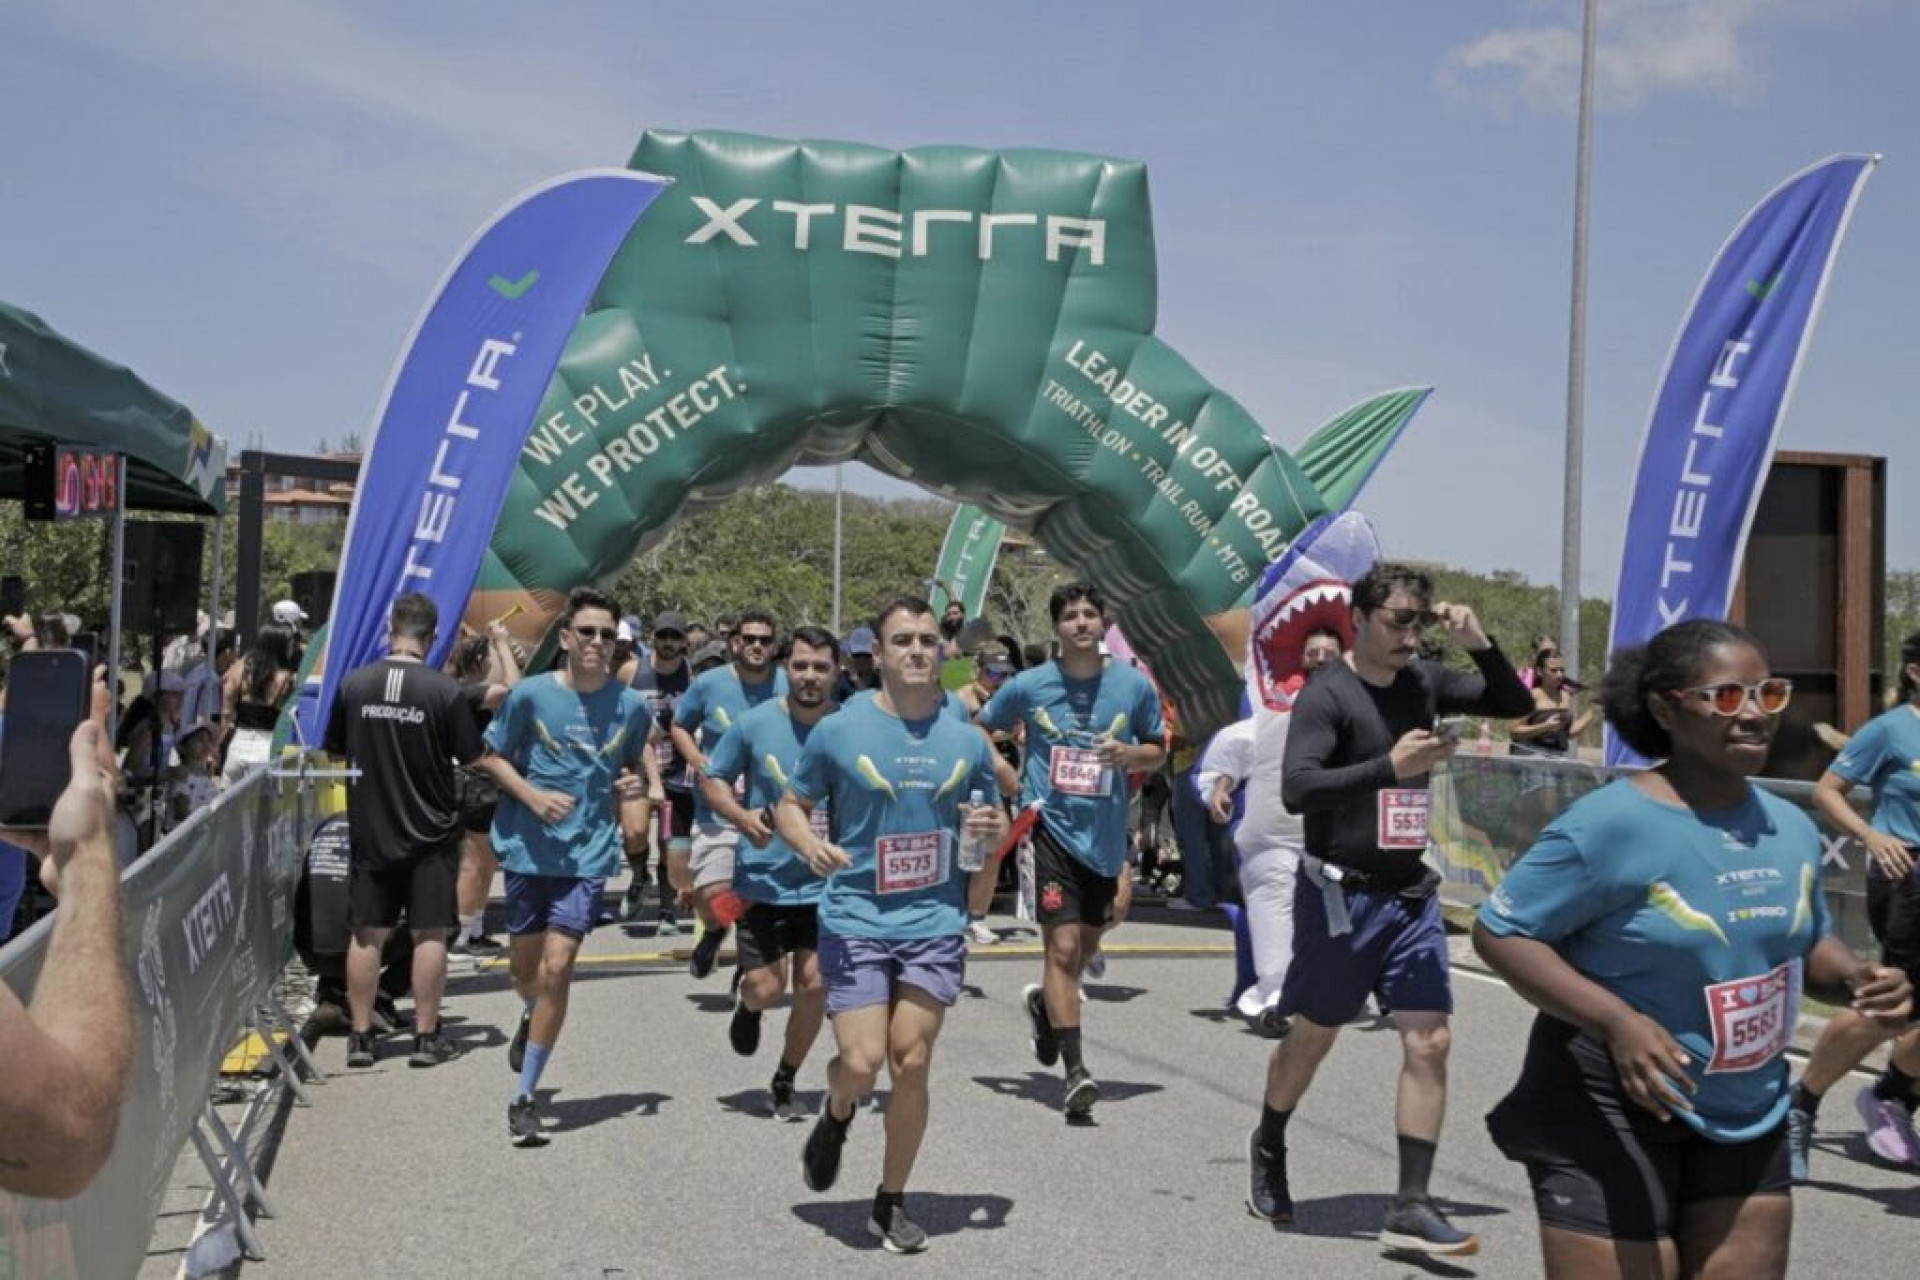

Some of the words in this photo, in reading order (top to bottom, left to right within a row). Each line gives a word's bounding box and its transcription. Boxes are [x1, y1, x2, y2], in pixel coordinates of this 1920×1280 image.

[683, 196, 1106, 265] XTERRA
[404, 337, 518, 580] TERRA
[521, 411, 585, 466] WE
[572, 353, 672, 427] PLAY.
[533, 472, 599, 531] WE
[586, 365, 748, 488] PROTECT.
[1065, 340, 1168, 429] LEADER
[1162, 420, 1198, 454] IN
[1191, 447, 1243, 492] OFF
[1230, 492, 1290, 563] ROAD
[1043, 379, 1133, 455] TRIATHLON
[1140, 457, 1184, 505] TRAIL
[1181, 500, 1214, 537] RUN
[1215, 545, 1250, 583] MTB
[361, 704, 425, 724] PRODUÇÃO
[889, 854, 932, 875] 5573
[1715, 867, 1782, 885] XTERRA
